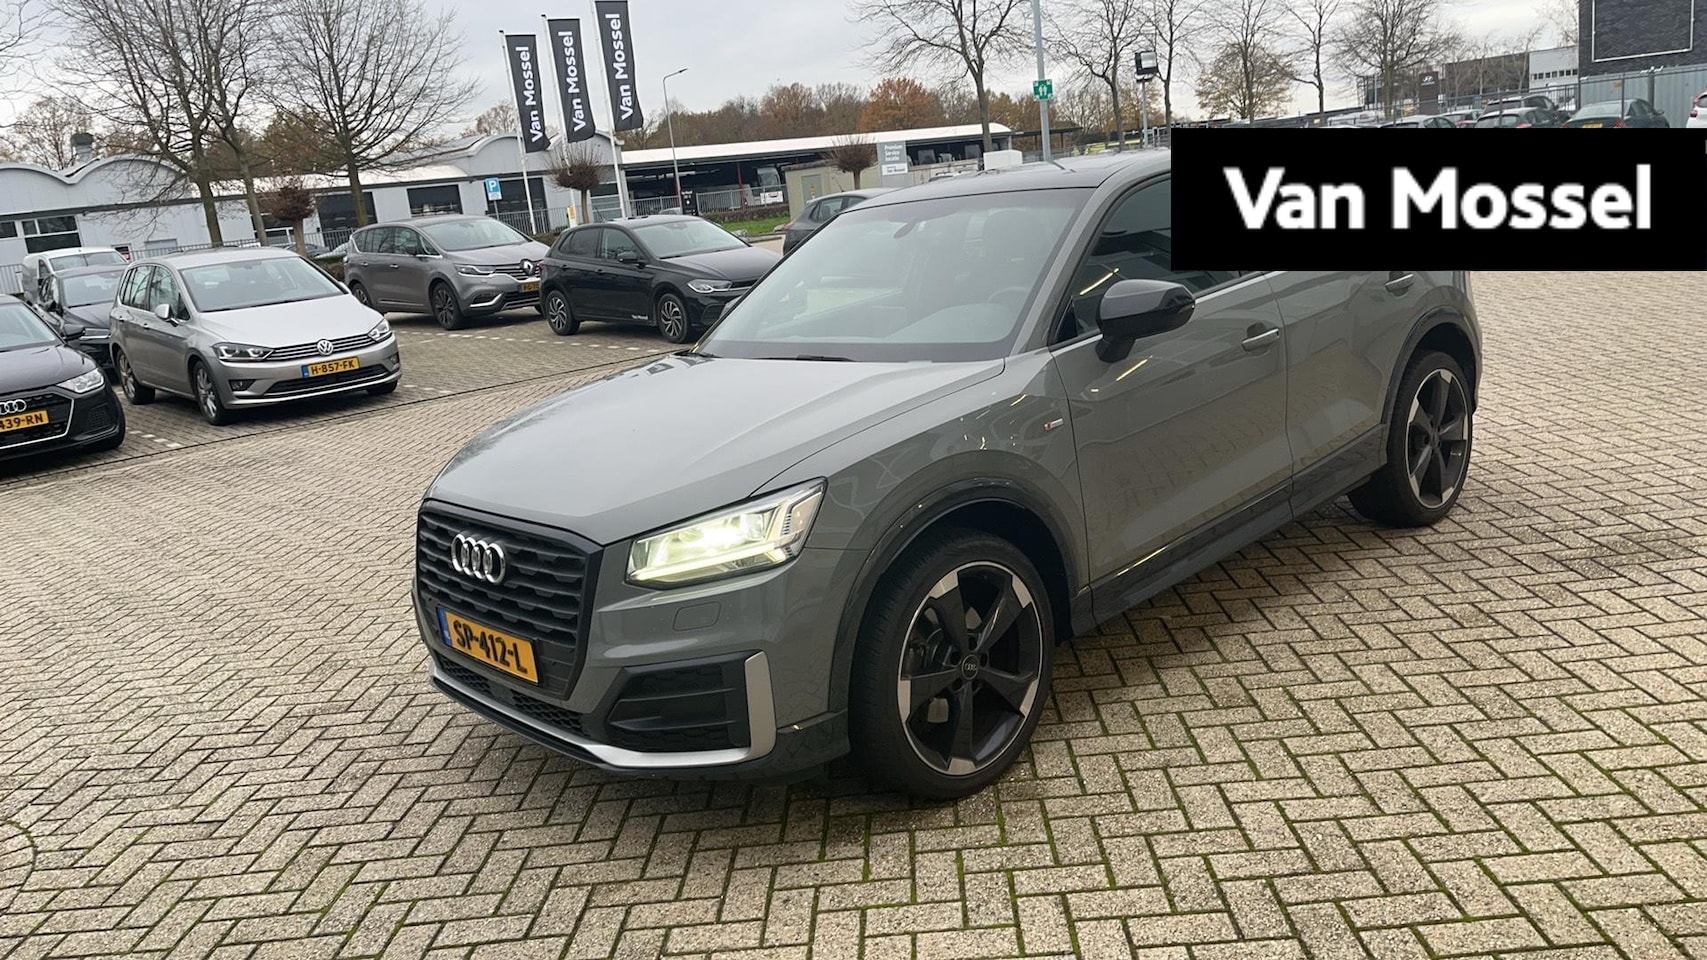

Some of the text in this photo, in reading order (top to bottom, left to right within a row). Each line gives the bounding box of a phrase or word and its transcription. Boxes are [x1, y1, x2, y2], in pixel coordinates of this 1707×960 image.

[515, 46, 543, 143] Van Mossel
[558, 31, 586, 132] Van Mossel
[605, 13, 634, 120] Van Mossel
[488, 180, 497, 192] P
[310, 359, 355, 375] H-857-FK
[453, 619, 528, 675] SP-412-L
